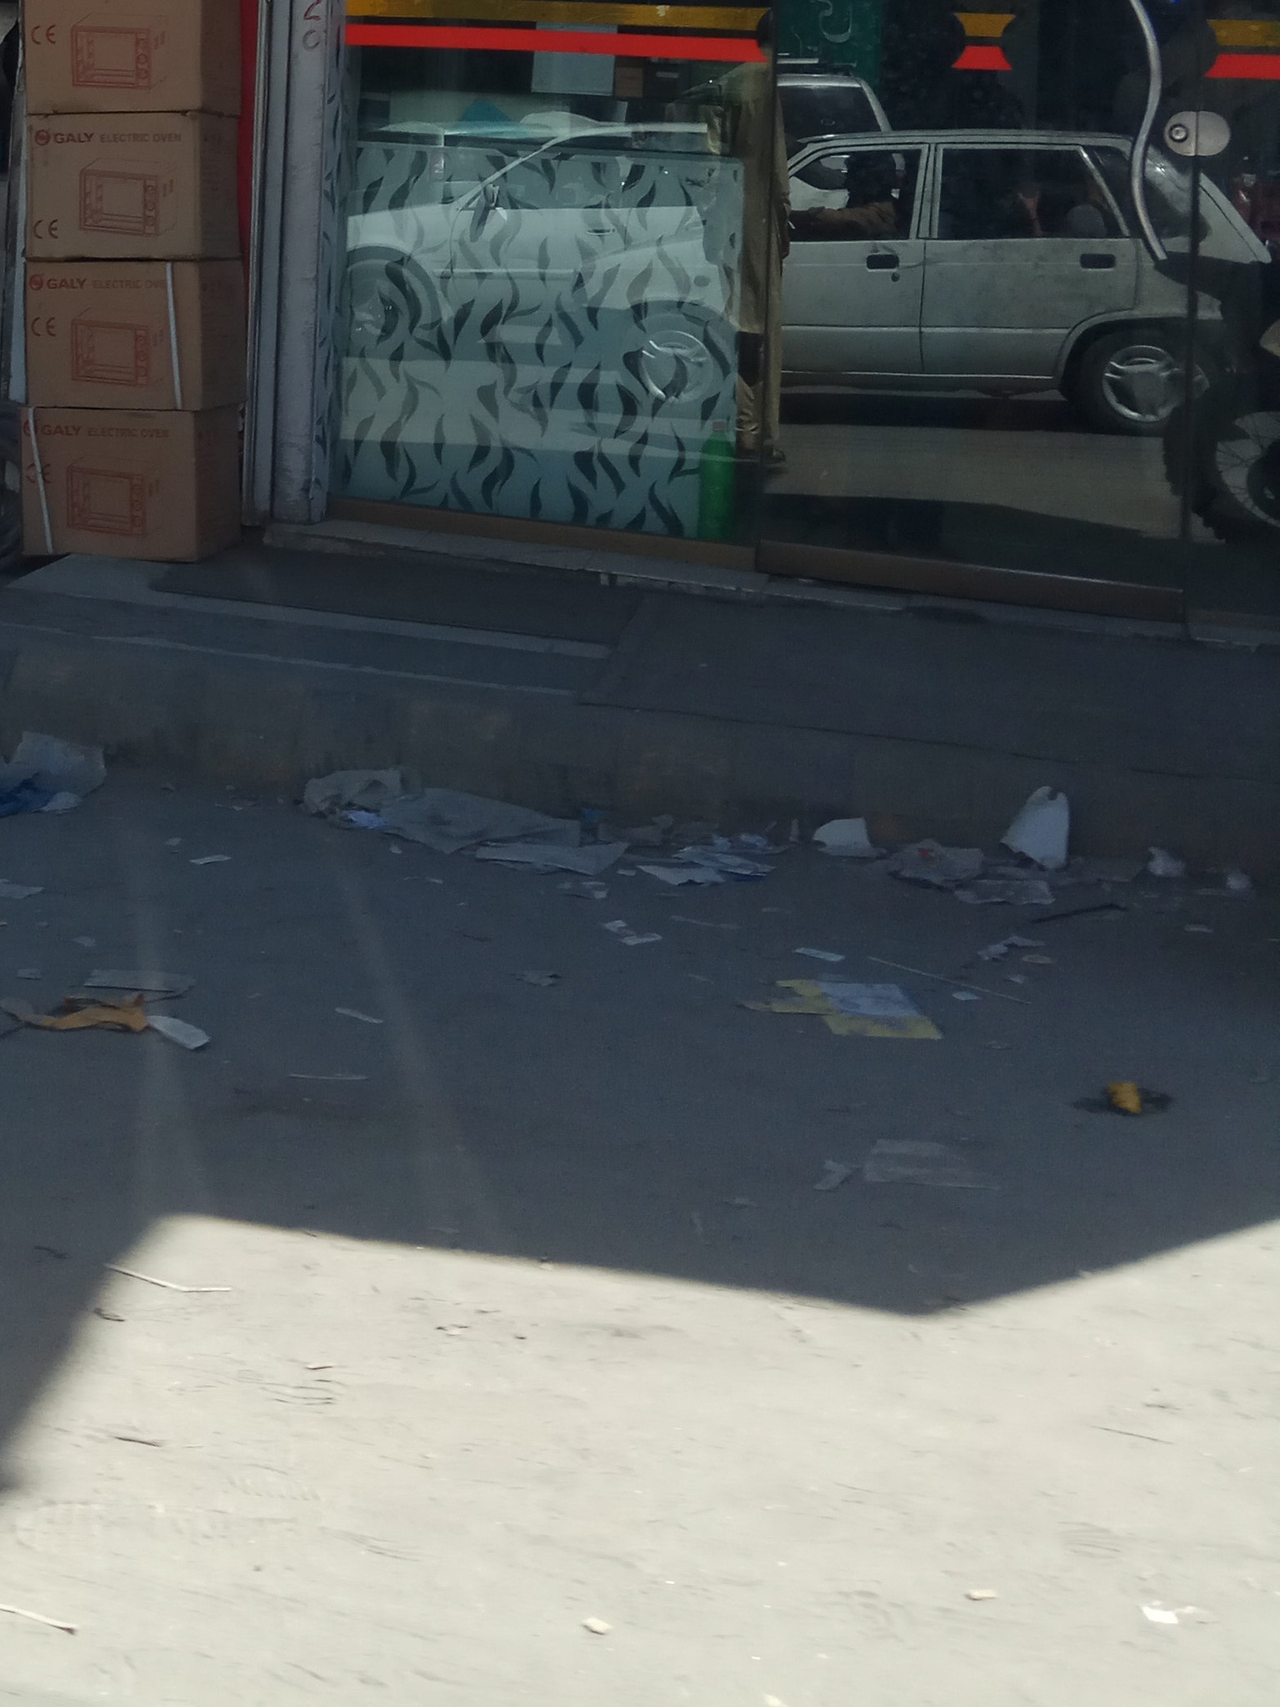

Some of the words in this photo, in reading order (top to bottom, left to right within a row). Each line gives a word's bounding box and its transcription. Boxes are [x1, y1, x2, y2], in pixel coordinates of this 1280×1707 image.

[54, 132, 95, 143] GALY
[100, 133, 150, 143] ELECTRIC
[153, 133, 182, 142] OVEN
[46, 278, 87, 290] GALY
[93, 279, 142, 290] ELECTRIC
[145, 279, 167, 289] OVE
[42, 425, 82, 437] GALY
[88, 427, 137, 438] ELECTRIC
